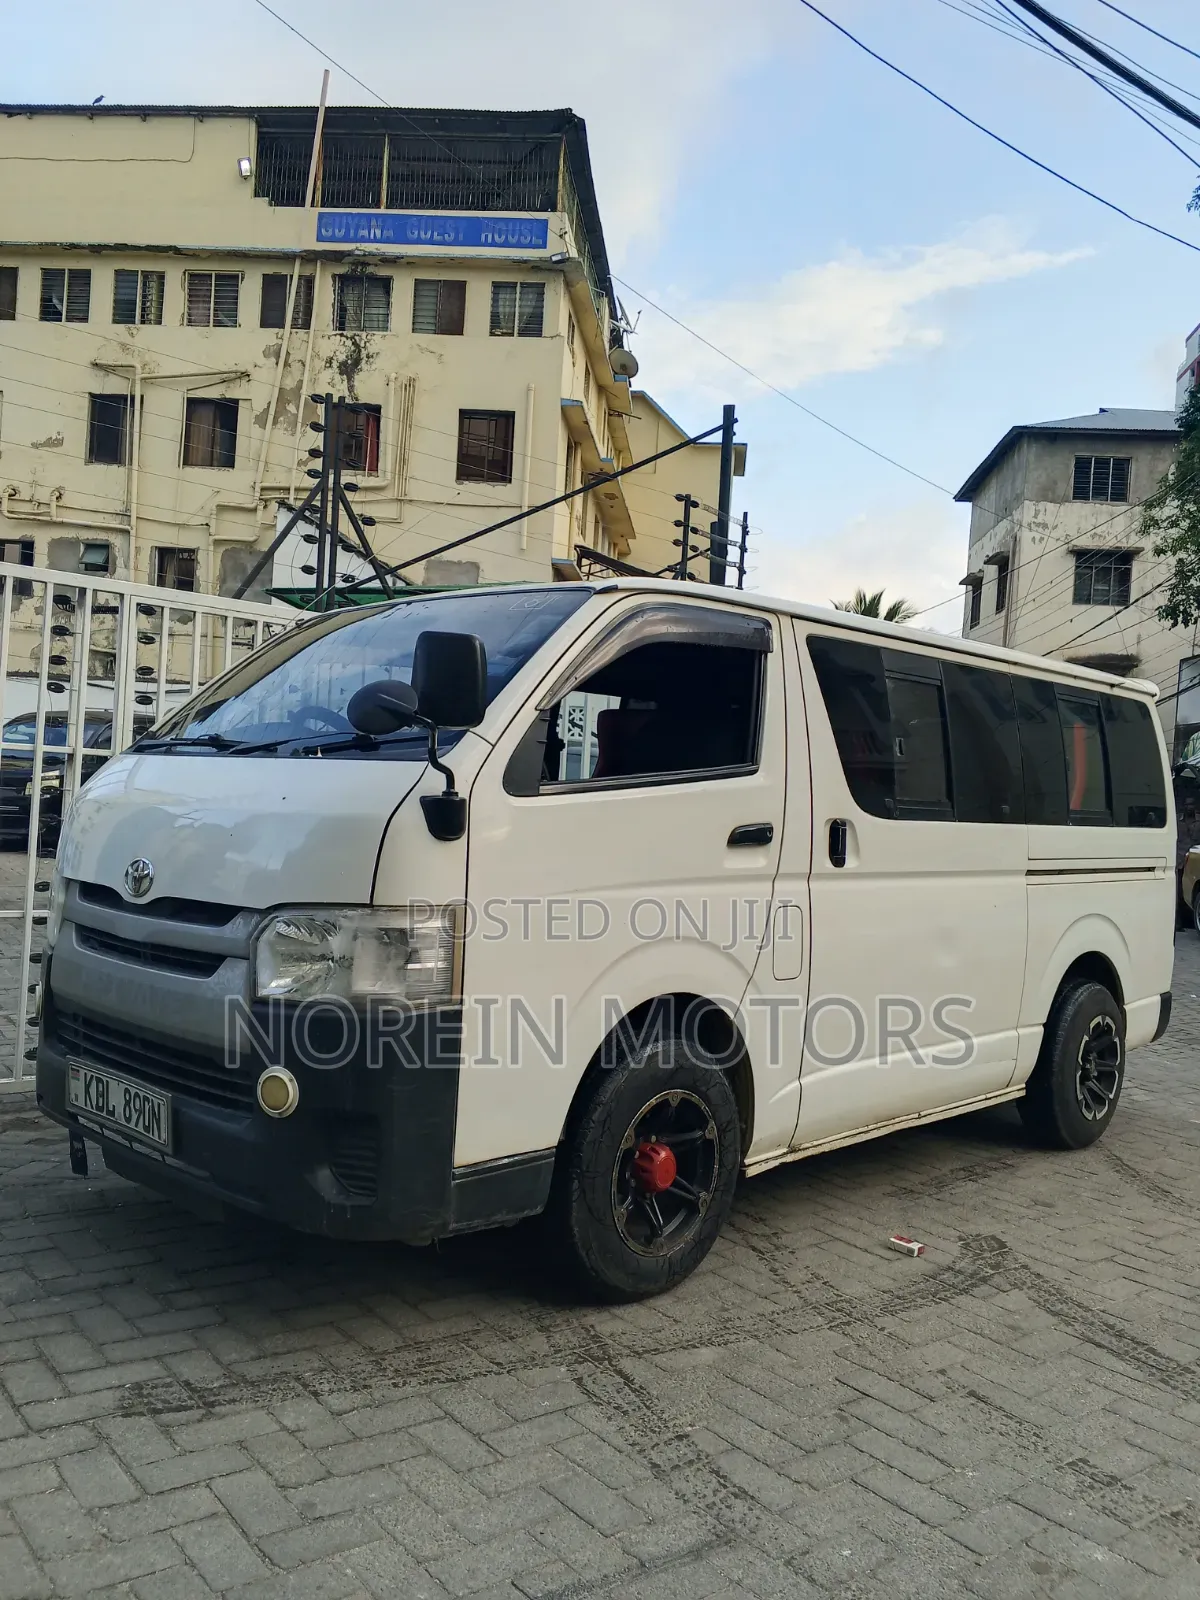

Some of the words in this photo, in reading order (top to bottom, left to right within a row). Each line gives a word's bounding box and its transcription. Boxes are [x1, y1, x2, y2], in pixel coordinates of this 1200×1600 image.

[321, 215, 394, 240] GUYANA
[406, 216, 468, 243] GUEST
[480, 219, 543, 245] HOUSE
[84, 1071, 116, 1118] KBL
